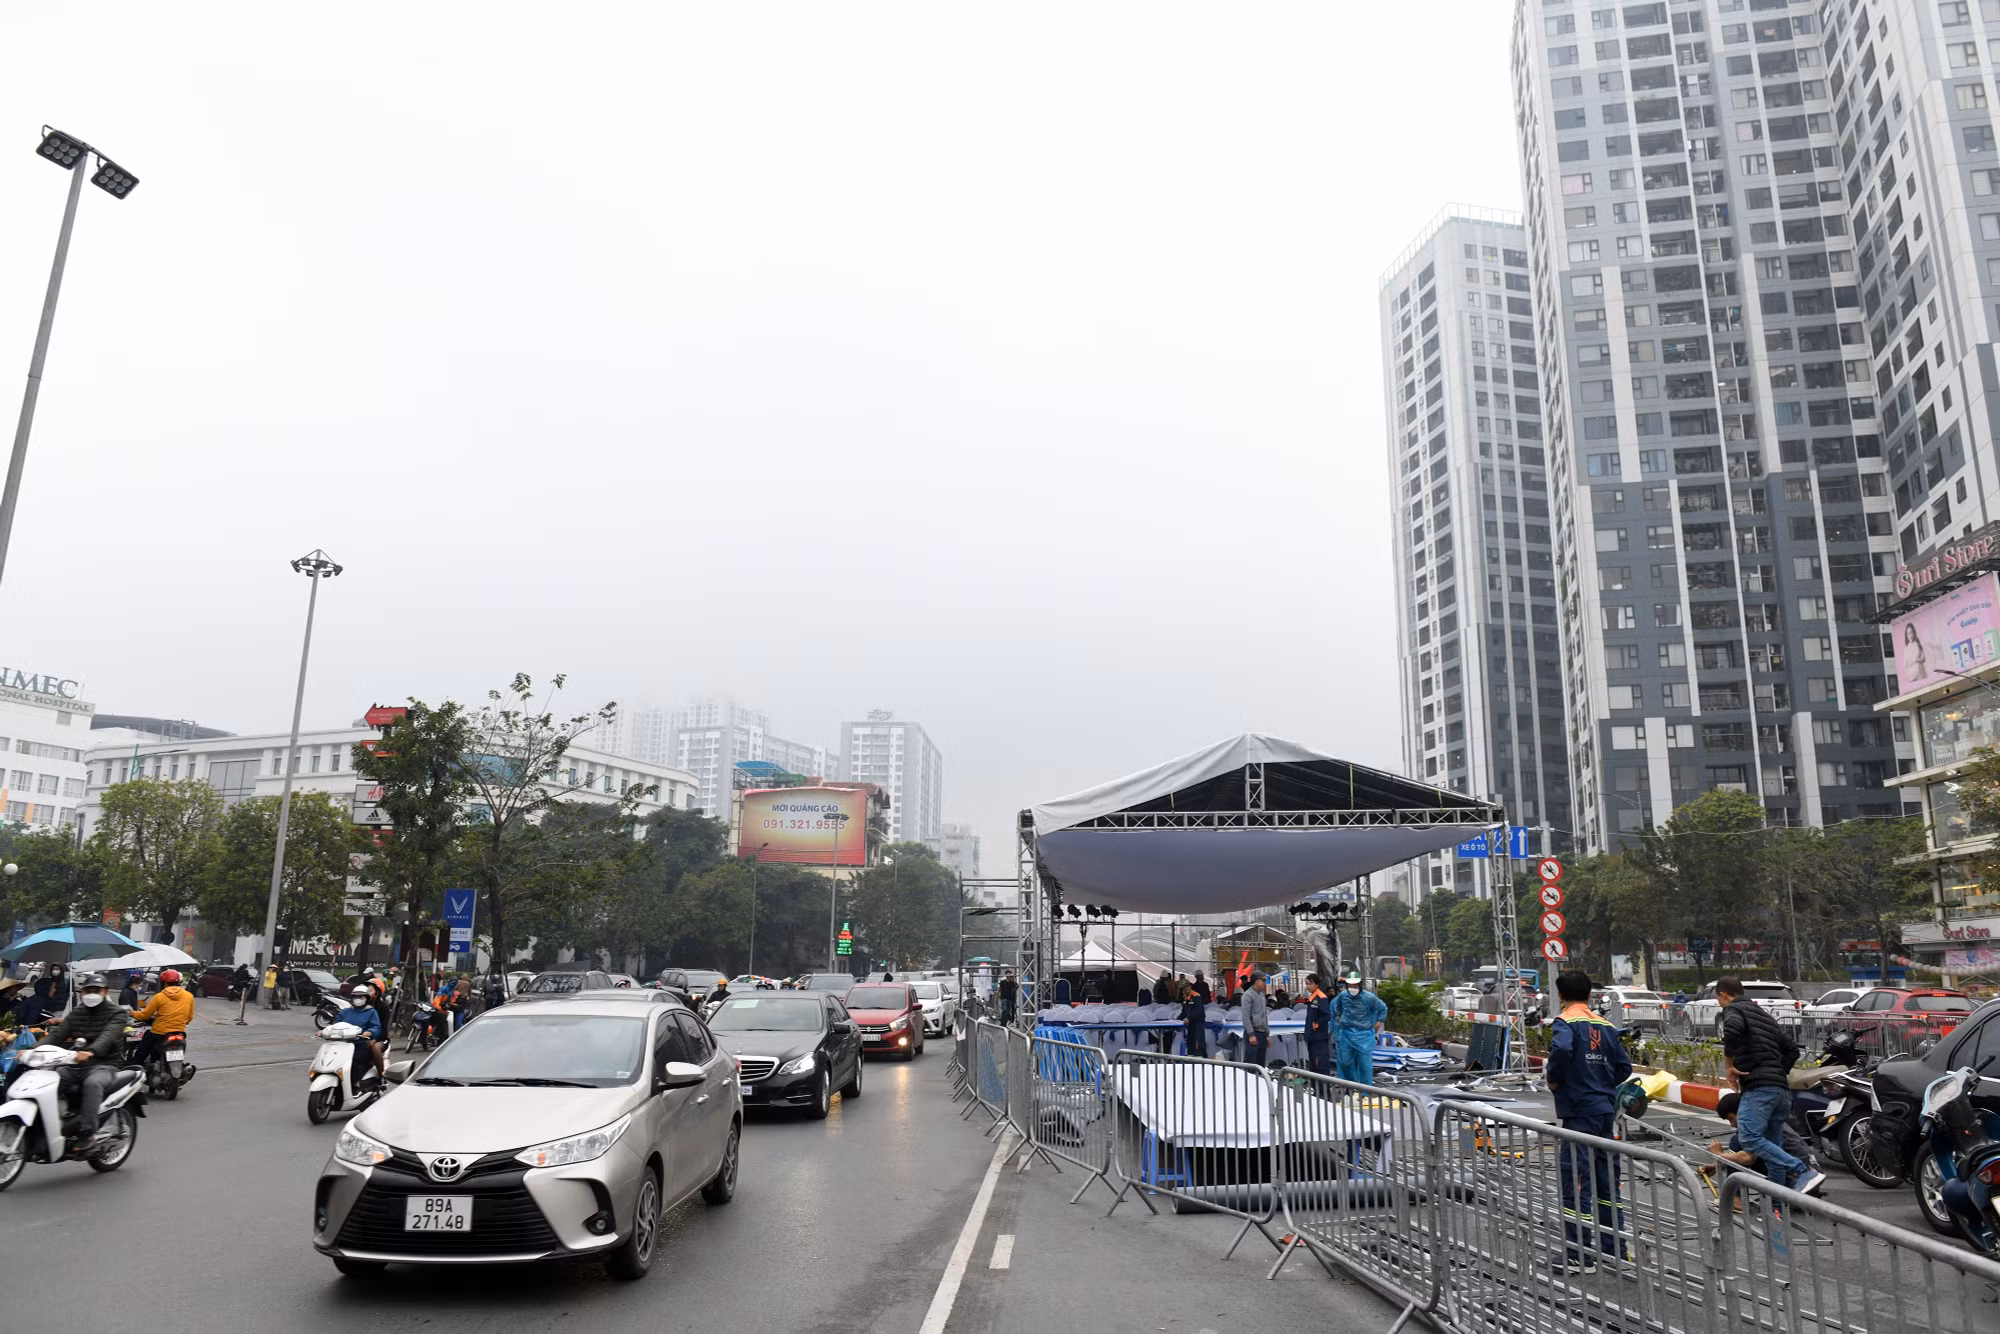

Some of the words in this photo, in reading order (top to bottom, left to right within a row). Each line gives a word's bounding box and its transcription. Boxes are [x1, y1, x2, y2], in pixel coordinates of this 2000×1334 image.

[1896, 556, 1941, 599] Suri
[1944, 535, 1993, 573] Store
[34, 695, 90, 712] HOSPITAL
[763, 819, 845, 829] 091.321.9555
[1477, 843, 1486, 851] TÔ
[425, 1199, 452, 1212] 89A
[412, 1215, 463, 1229] 271.48
